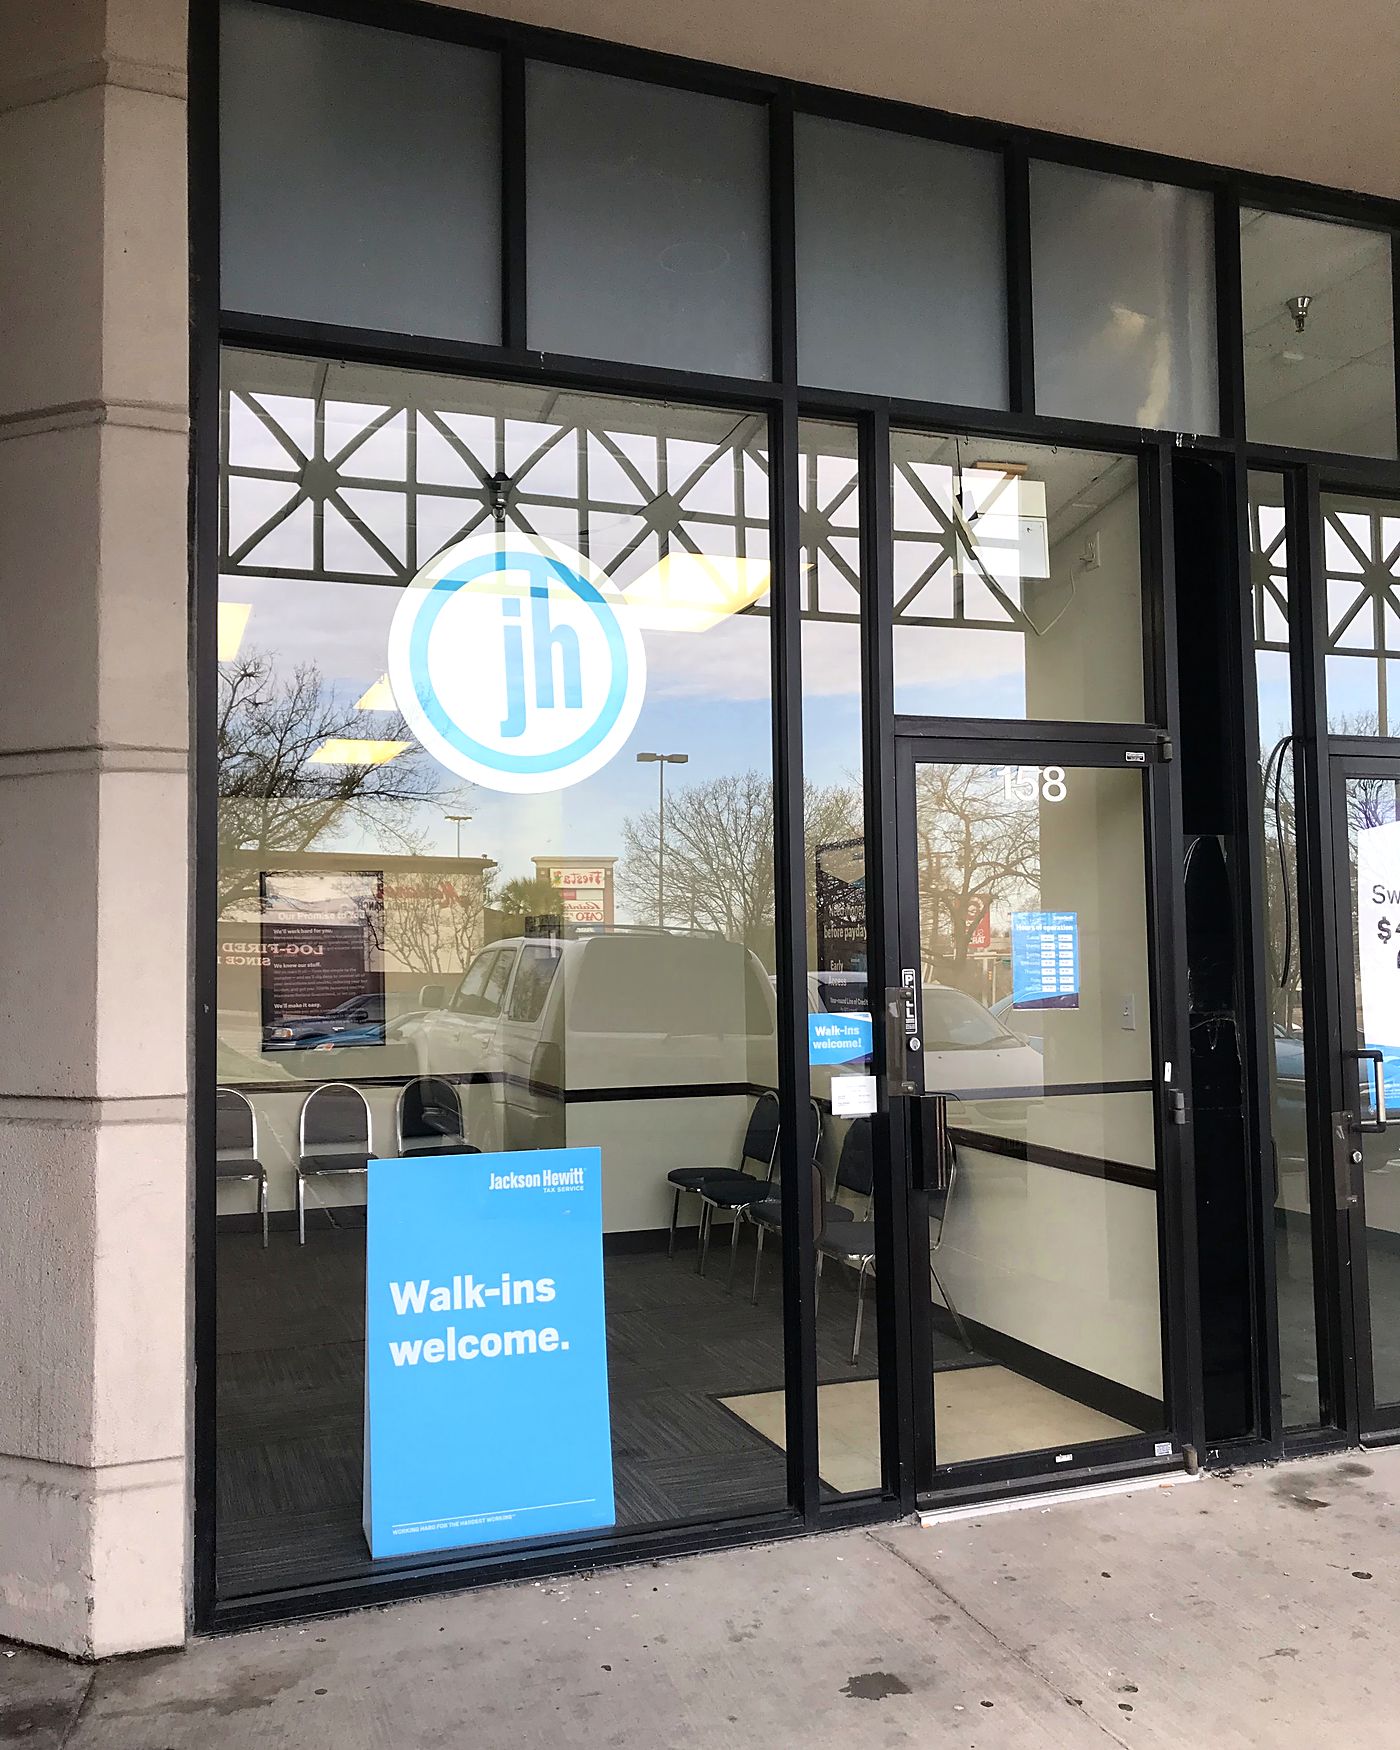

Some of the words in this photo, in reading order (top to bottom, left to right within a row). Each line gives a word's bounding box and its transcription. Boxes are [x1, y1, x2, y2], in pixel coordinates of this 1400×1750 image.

[500, 570, 583, 737] jh
[996, 765, 1067, 802] 158
[278, 911, 295, 920] Our
[297, 911, 335, 920] Promise
[823, 924, 844, 939] before
[844, 923, 867, 941] payday
[830, 959, 844, 974] Early
[905, 974, 914, 1017] PLL
[815, 1024, 860, 1037] Walk-ins
[813, 1037, 862, 1050] welcome!
[489, 1171, 540, 1190] Jackson
[542, 1167, 585, 1187] Hewitt
[557, 1185, 585, 1193] SERVICE
[389, 1272, 557, 1316] Walk-ins
[389, 1326, 570, 1367] welcome.
[437, 1522, 448, 1530] FOR
